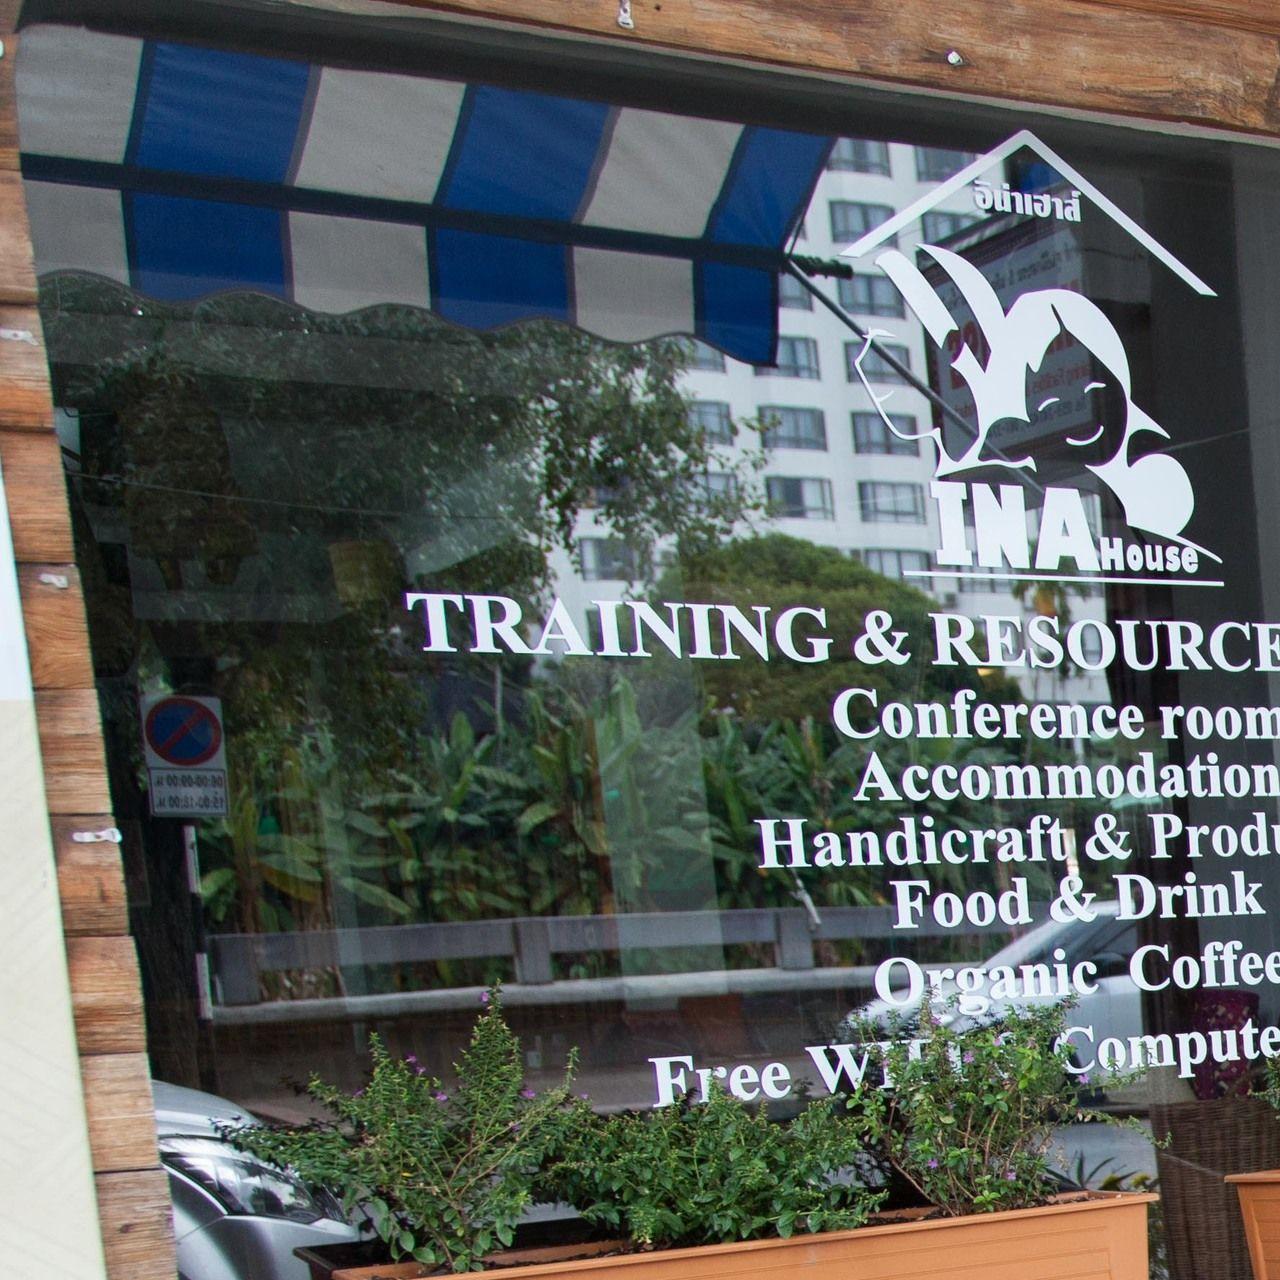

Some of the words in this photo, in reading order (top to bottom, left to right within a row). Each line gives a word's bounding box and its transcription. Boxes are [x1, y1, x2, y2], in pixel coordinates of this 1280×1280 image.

[930, 480, 1102, 571] INA
[1101, 536, 1199, 574] House
[405, 592, 835, 664] TRAINING
[853, 609, 912, 665] &
[832, 687, 1145, 740] Conference
[754, 813, 1068, 870] Handicraft
[1085, 812, 1133, 862] &
[889, 876, 1034, 930] Food
[1049, 873, 1098, 924] &
[1112, 869, 1267, 921] Drink
[874, 947, 1099, 1016] Organic
[648, 1055, 792, 1109] Free
